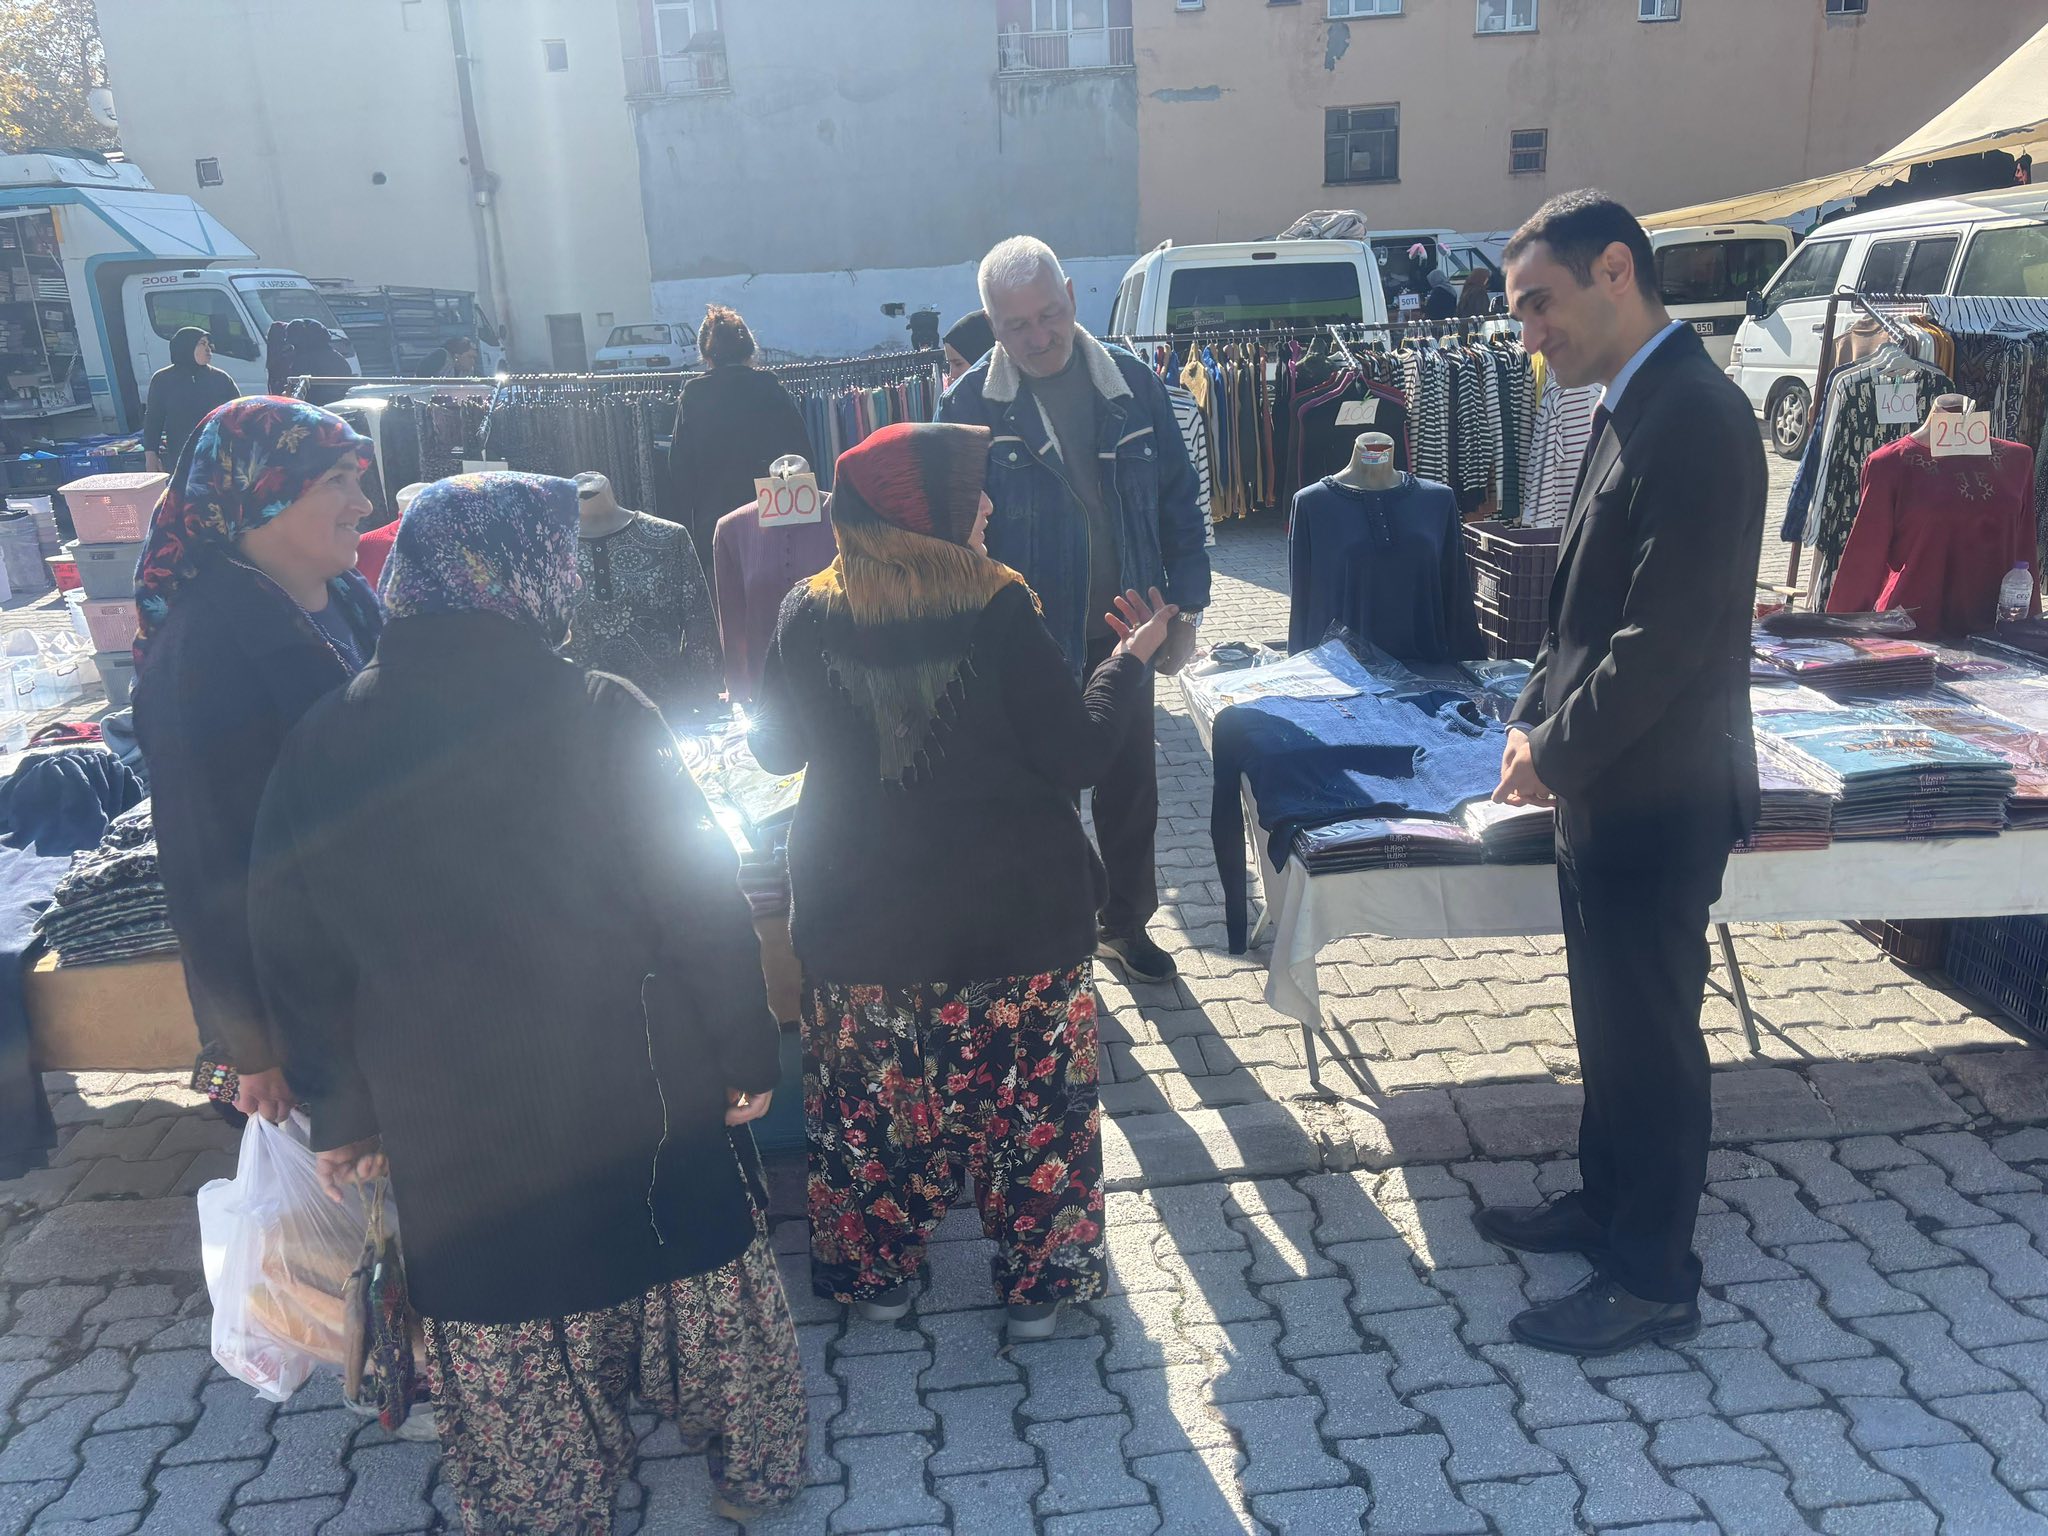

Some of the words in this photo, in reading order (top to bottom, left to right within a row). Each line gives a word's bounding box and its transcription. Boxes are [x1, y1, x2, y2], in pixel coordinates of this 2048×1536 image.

[142, 275, 178, 285] 2008
[1341, 405, 1375, 422] 100
[1881, 393, 1915, 414] 400
[1936, 420, 1988, 447] 250
[759, 484, 816, 519] 200
